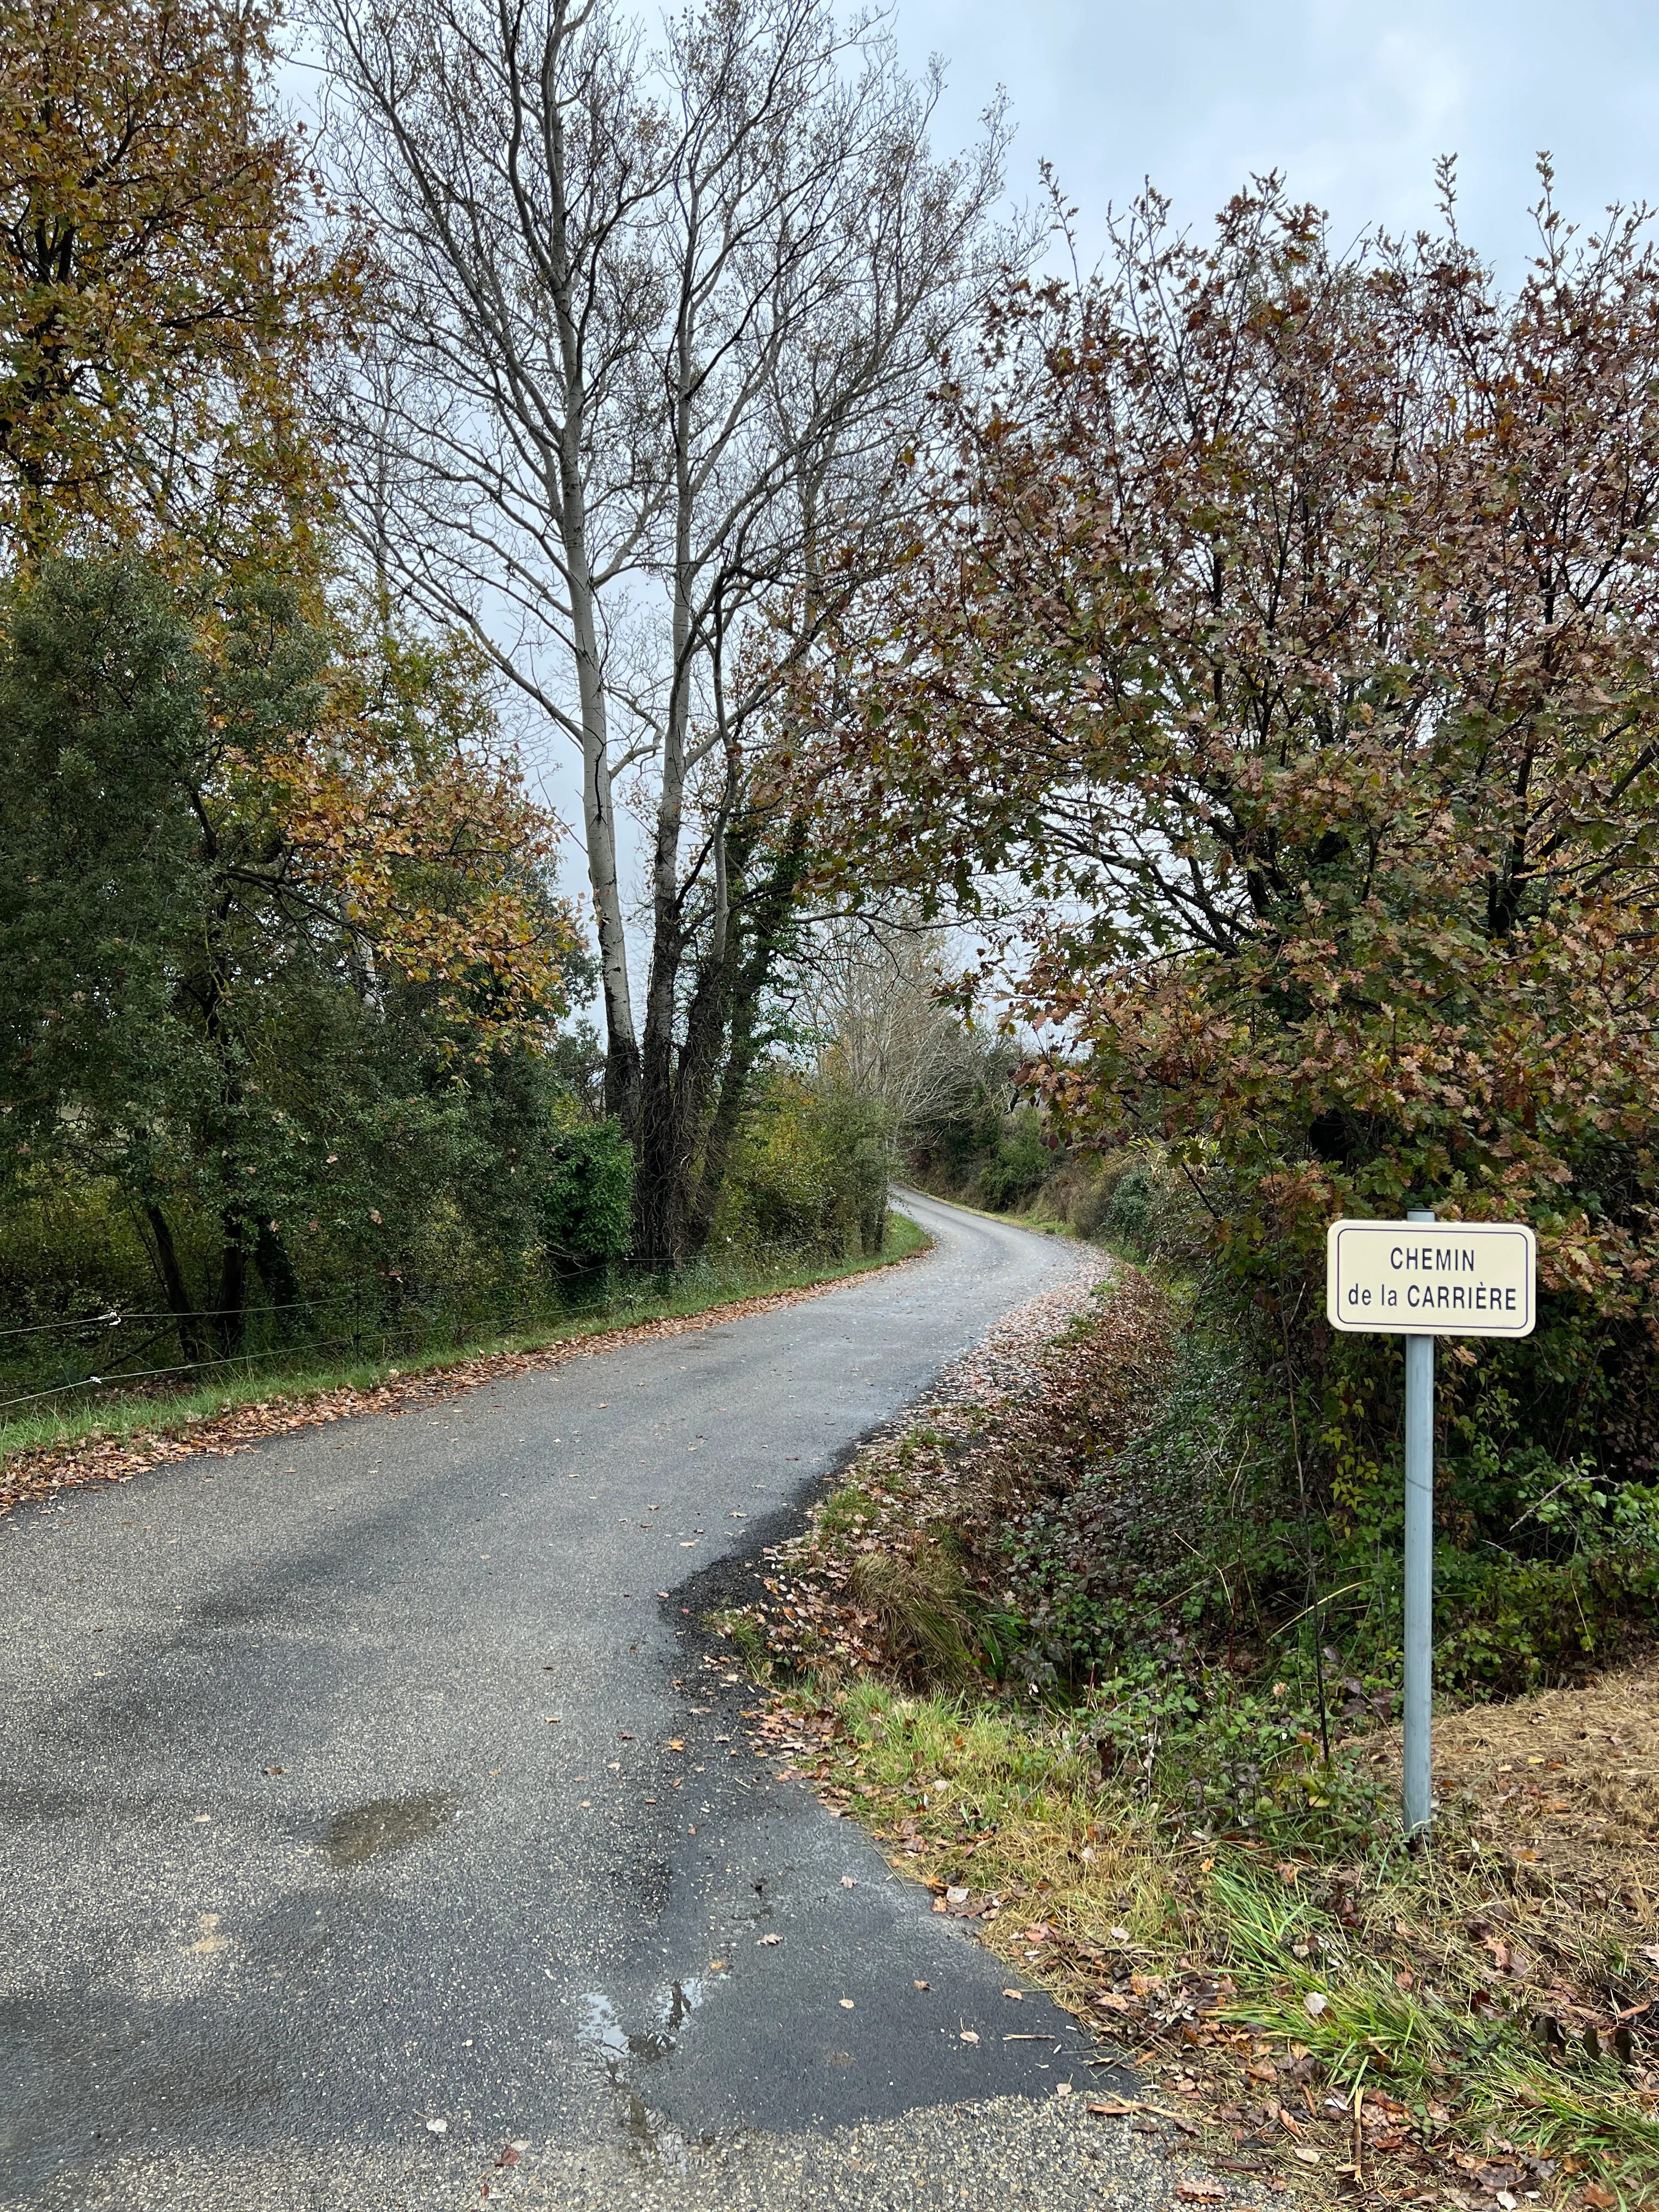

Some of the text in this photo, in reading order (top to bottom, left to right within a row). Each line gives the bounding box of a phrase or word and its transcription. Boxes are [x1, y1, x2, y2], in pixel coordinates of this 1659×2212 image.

[1390, 1246, 1474, 1272] CHEMIN
[1348, 1282, 1516, 1311] de la CARRIÈRE
